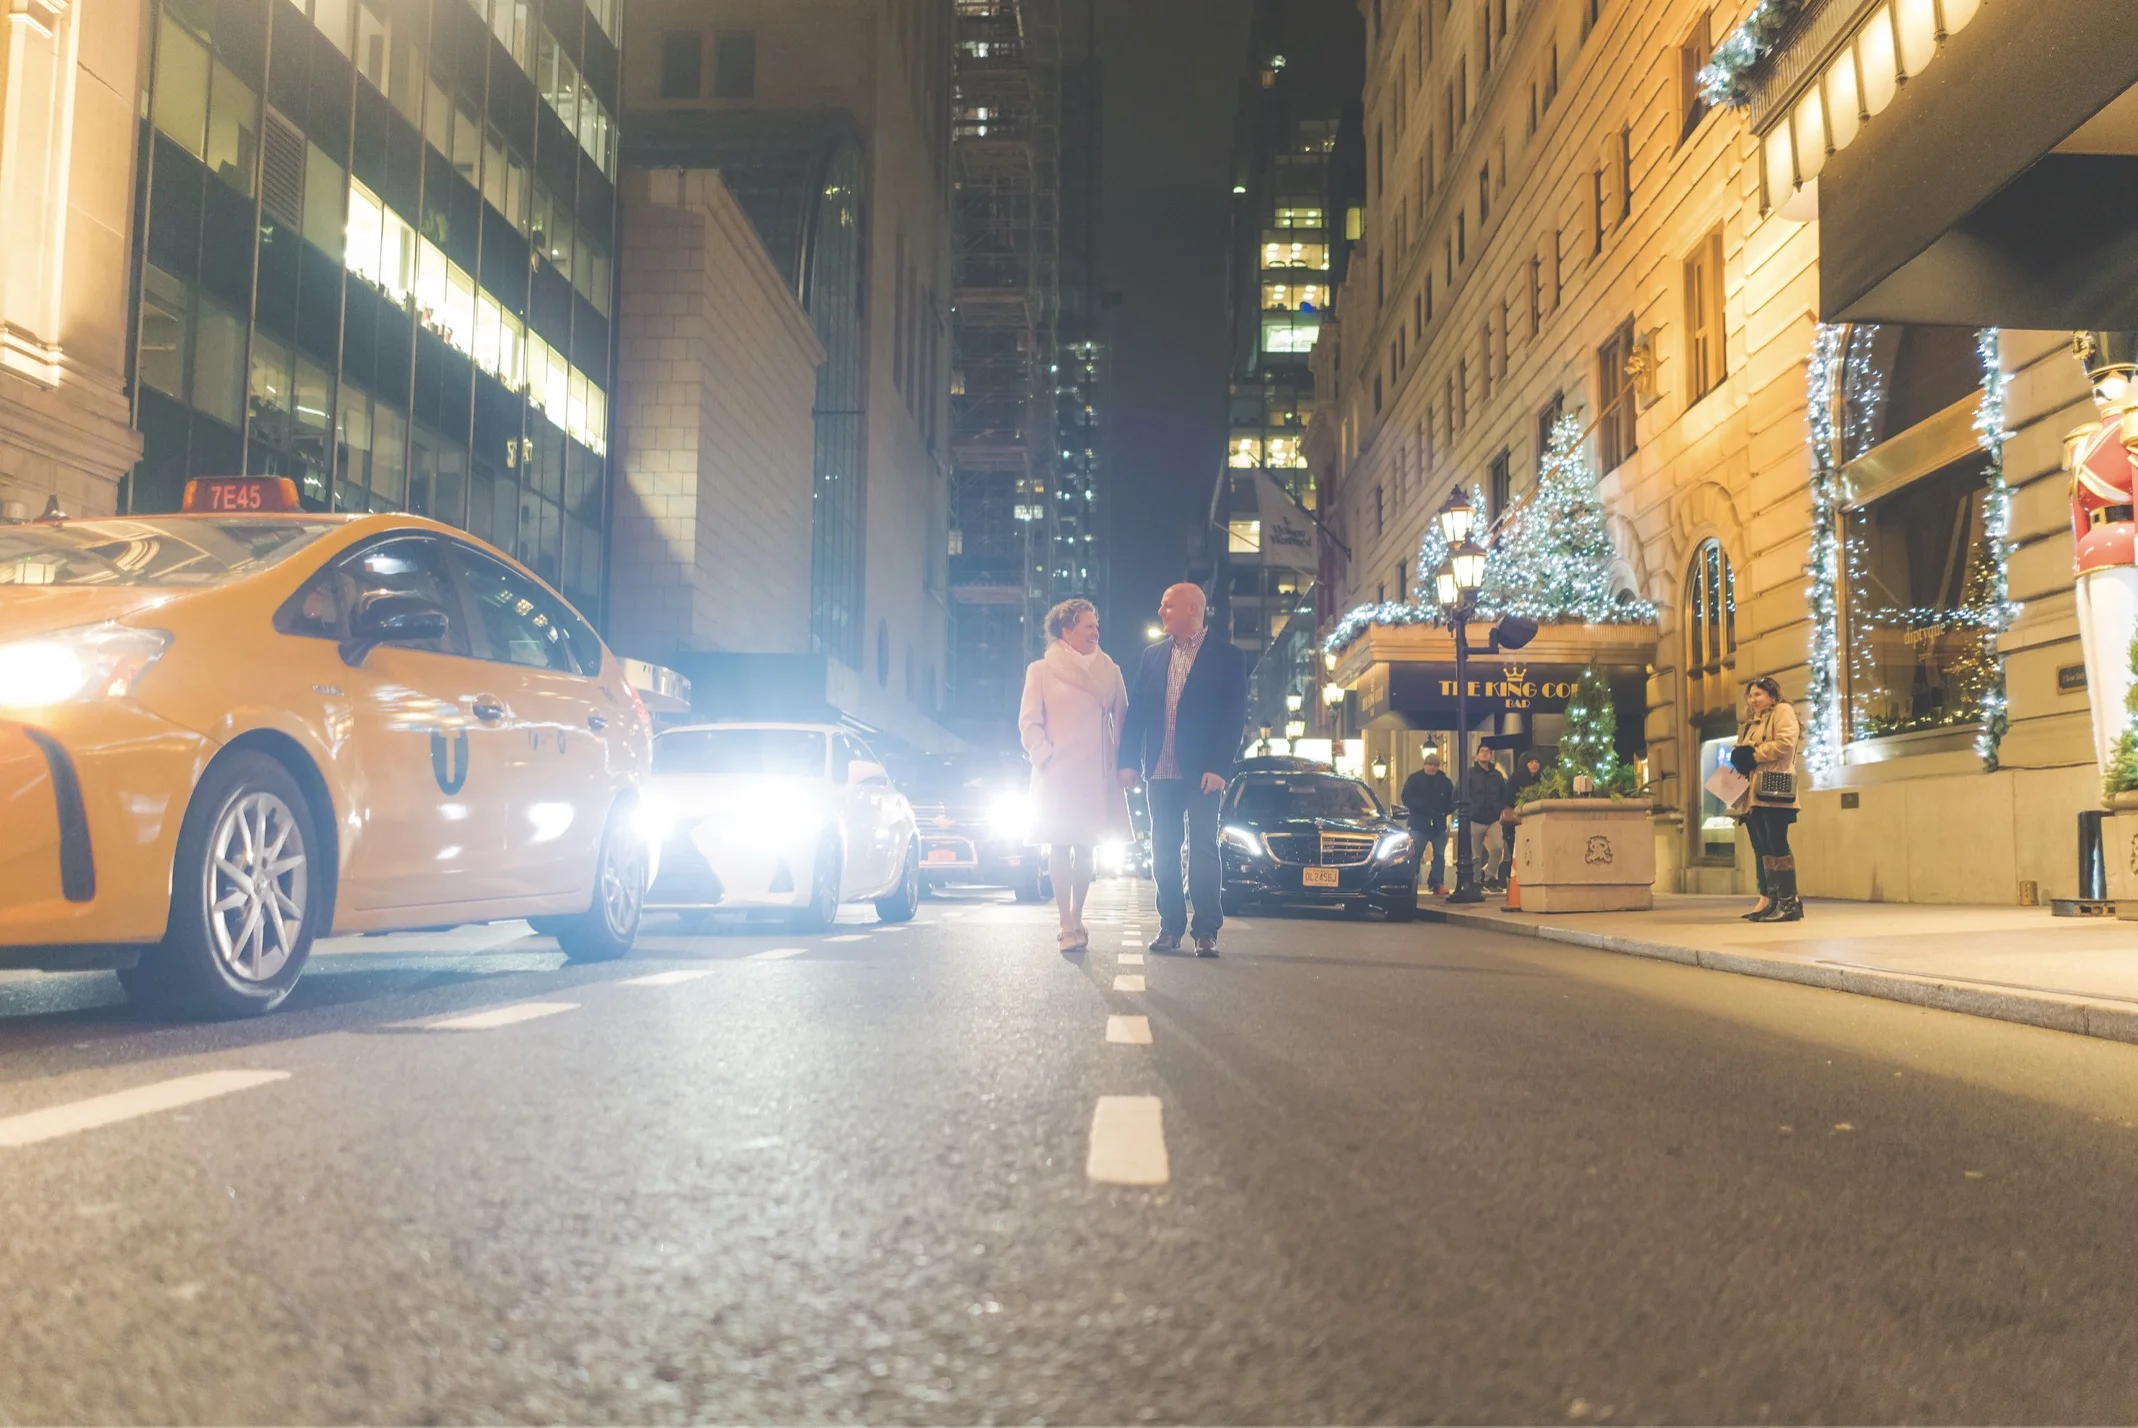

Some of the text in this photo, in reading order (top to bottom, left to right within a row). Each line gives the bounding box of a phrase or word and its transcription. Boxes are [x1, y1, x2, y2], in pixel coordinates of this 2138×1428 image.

[211, 484, 262, 510] 7E45
[1904, 622, 1946, 650] diptyque
[1485, 681, 1538, 698] KING
[1505, 698, 1531, 709] BAR
